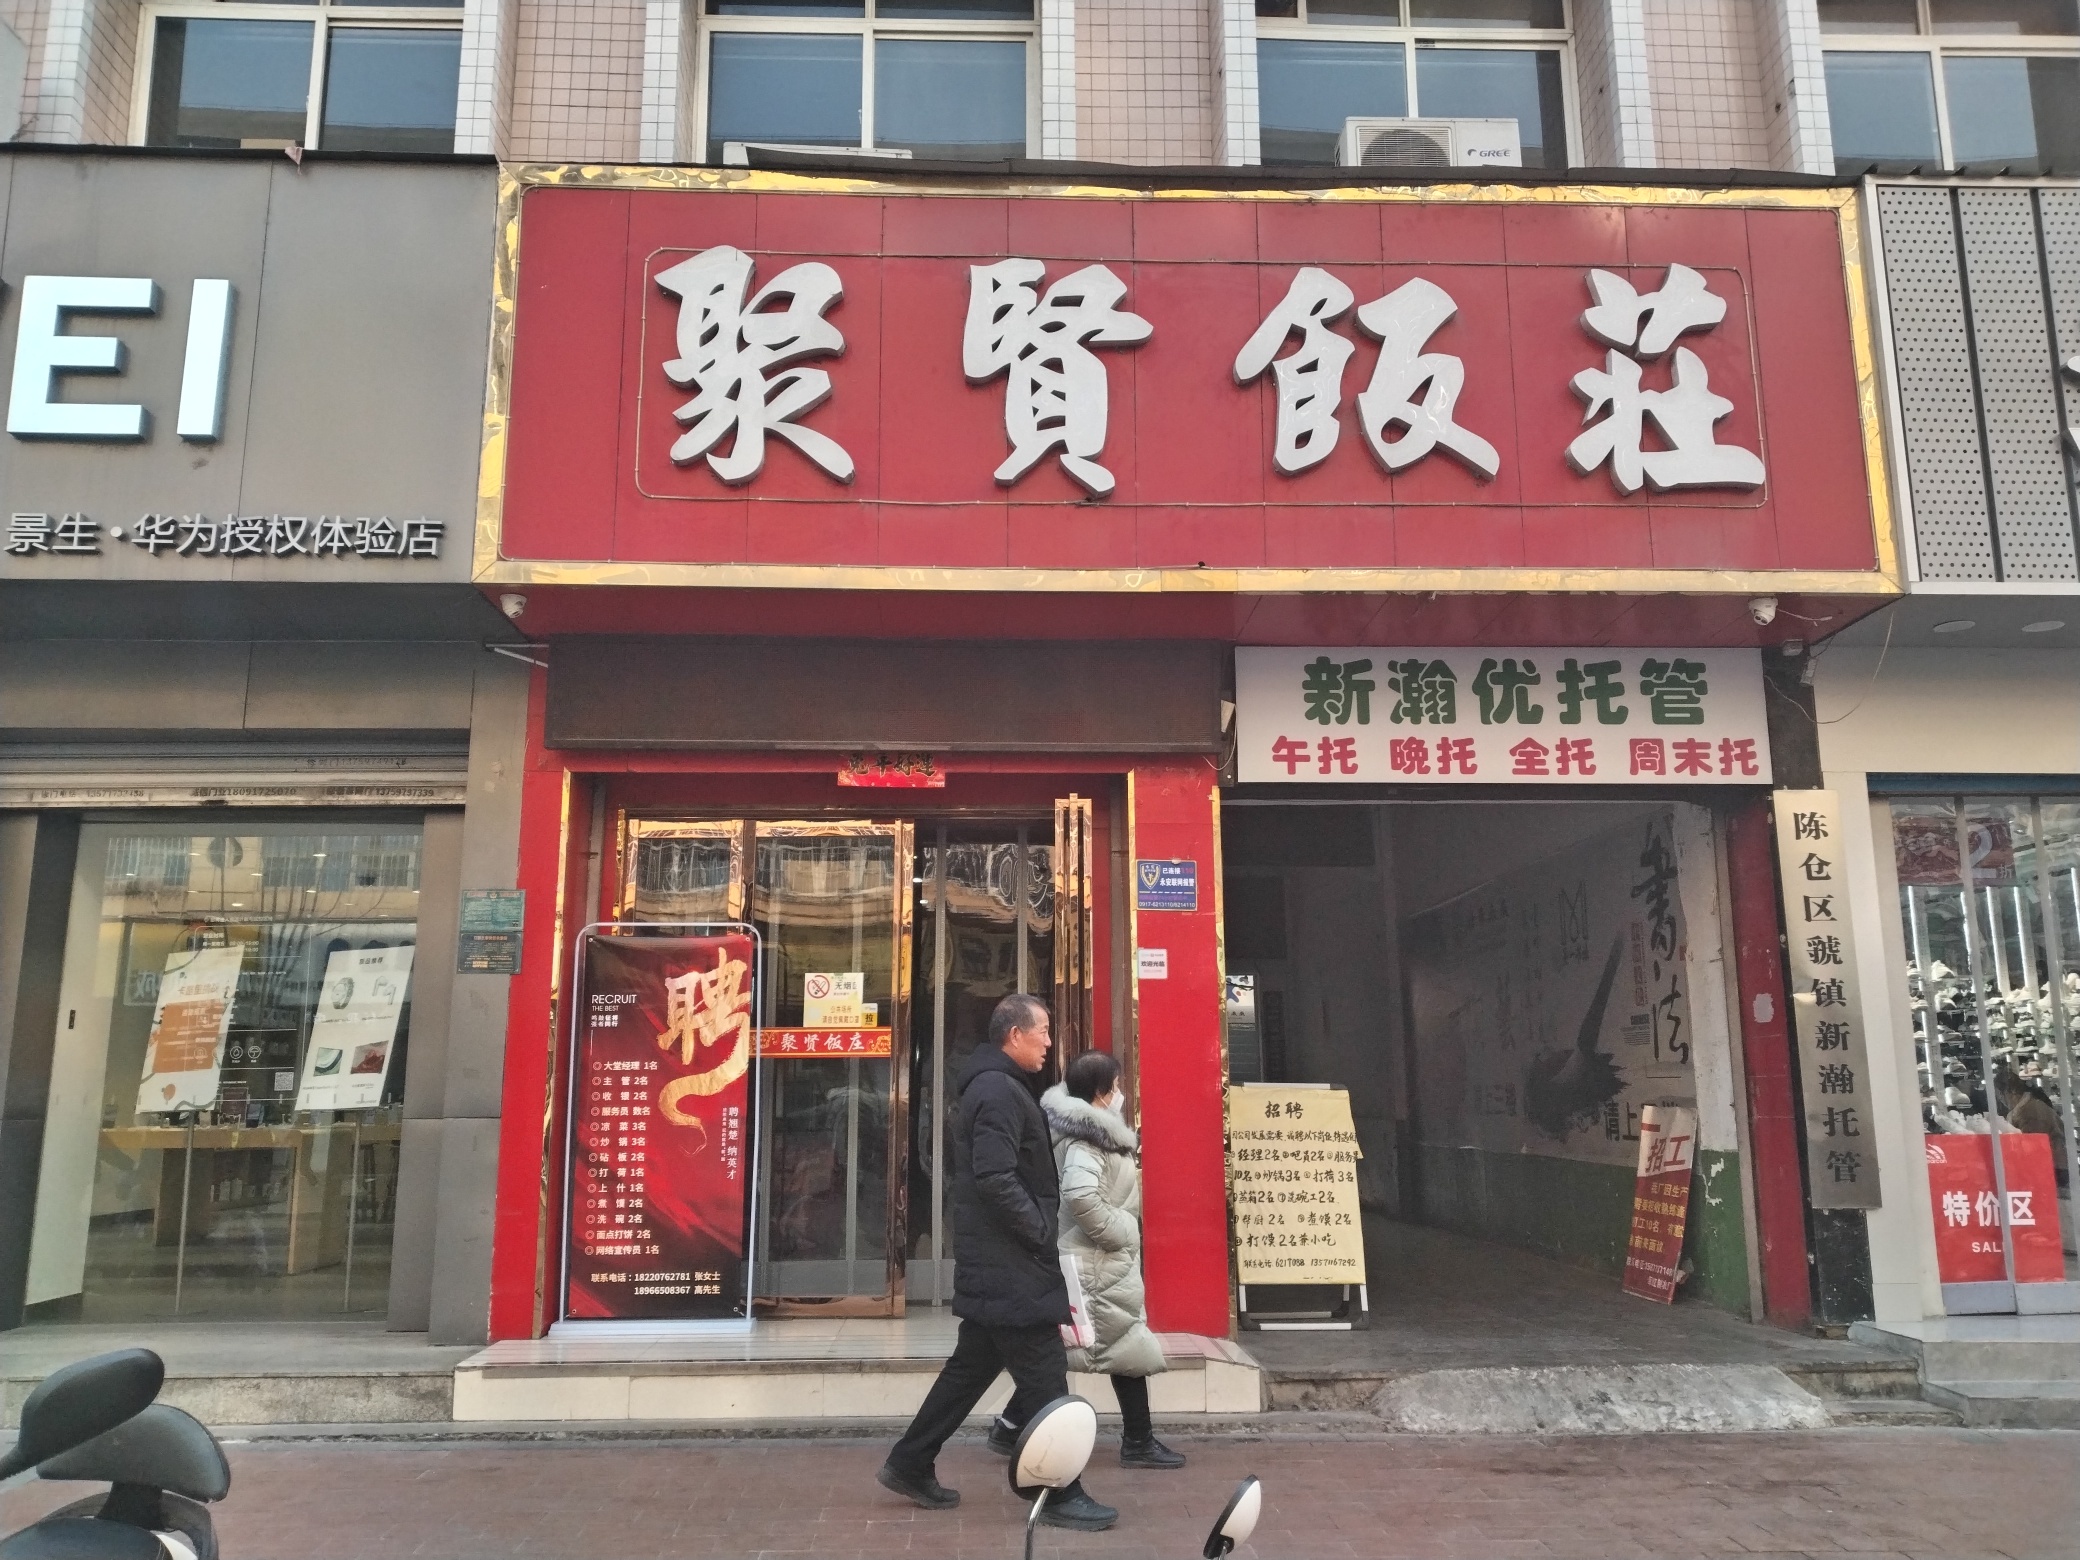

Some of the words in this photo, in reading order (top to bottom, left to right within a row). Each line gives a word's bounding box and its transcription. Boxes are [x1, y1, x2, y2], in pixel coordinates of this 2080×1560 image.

[1479, 149, 1511, 158] GREE
[1301, 655, 1708, 725] 新瀚优托管
[1272, 735, 1359, 775] 午托
[1389, 735, 1478, 775] 晚托
[1509, 736, 1597, 776] 全托
[1629, 737, 1759, 776] 周末托
[591, 994, 637, 1004] RECRUIT
[865, 1013, 874, 1023] 拉
[780, 1032, 865, 1052] 聚贤饭庄
[603, 1061, 640, 1071] 大堂经理
[1265, 1101, 1304, 1120] 招聘
[1645, 1135, 1690, 1173] 招工
[1942, 1190, 2036, 1227] 特价区
[595, 1245, 642, 1256] 网络宣传员
[1971, 1241, 2003, 1253] SAL
[694, 1271, 721, 1281] 张女士
[634, 1286, 690, 1295] 18966508367
[694, 1285, 721, 1295] 高先生
